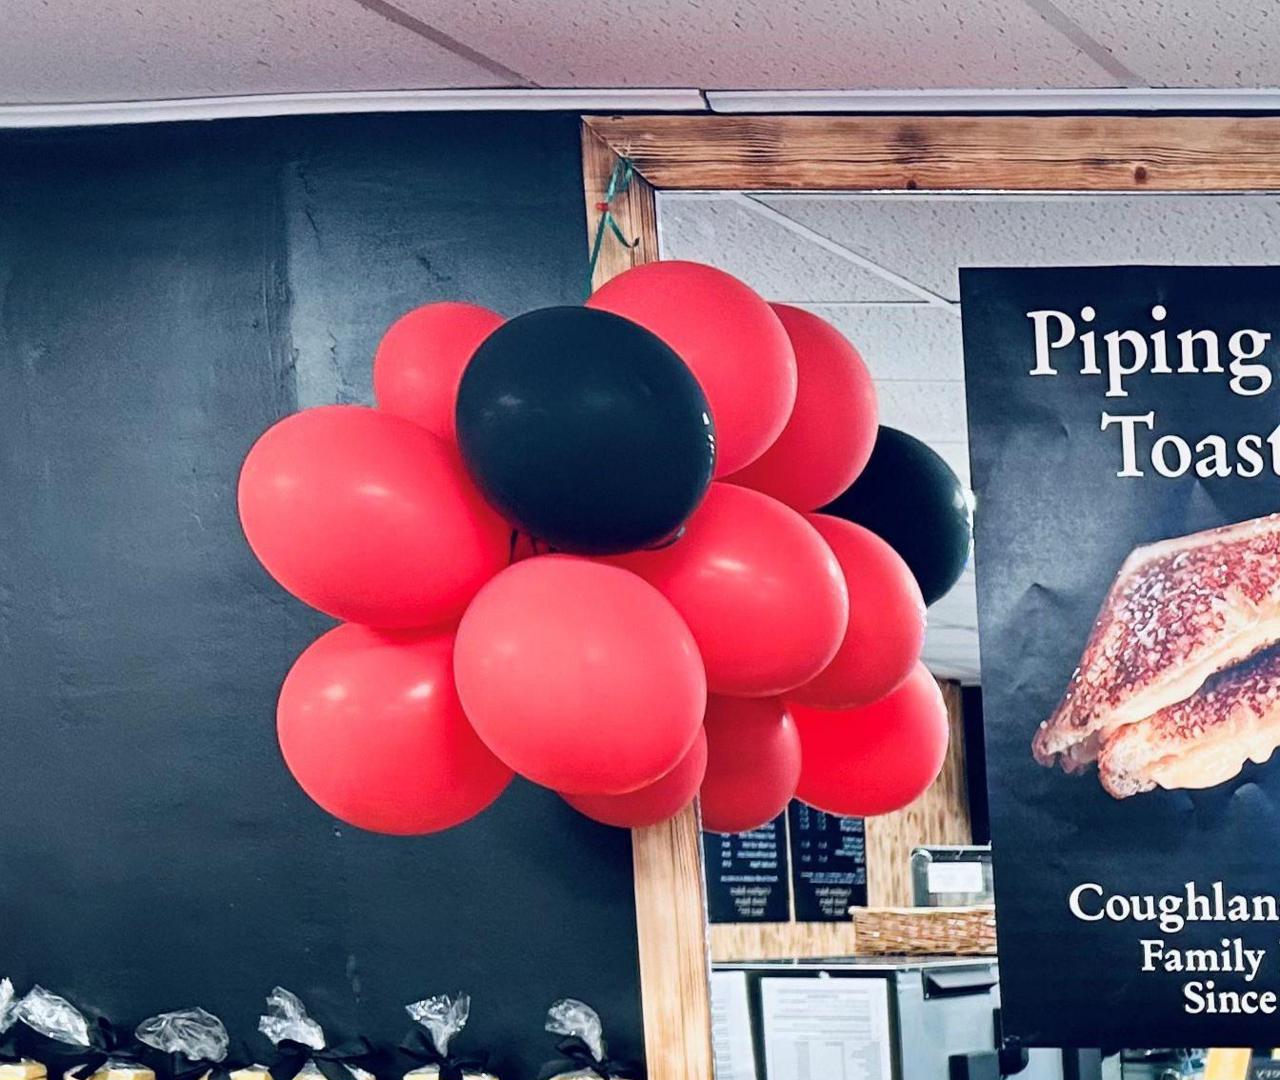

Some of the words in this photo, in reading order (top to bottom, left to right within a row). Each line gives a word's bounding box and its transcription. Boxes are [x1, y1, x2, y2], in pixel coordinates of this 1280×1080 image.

[1024, 303, 1272, 400] Piping
[1140, 937, 1266, 982] Family
[1183, 982, 1277, 1015] Since
